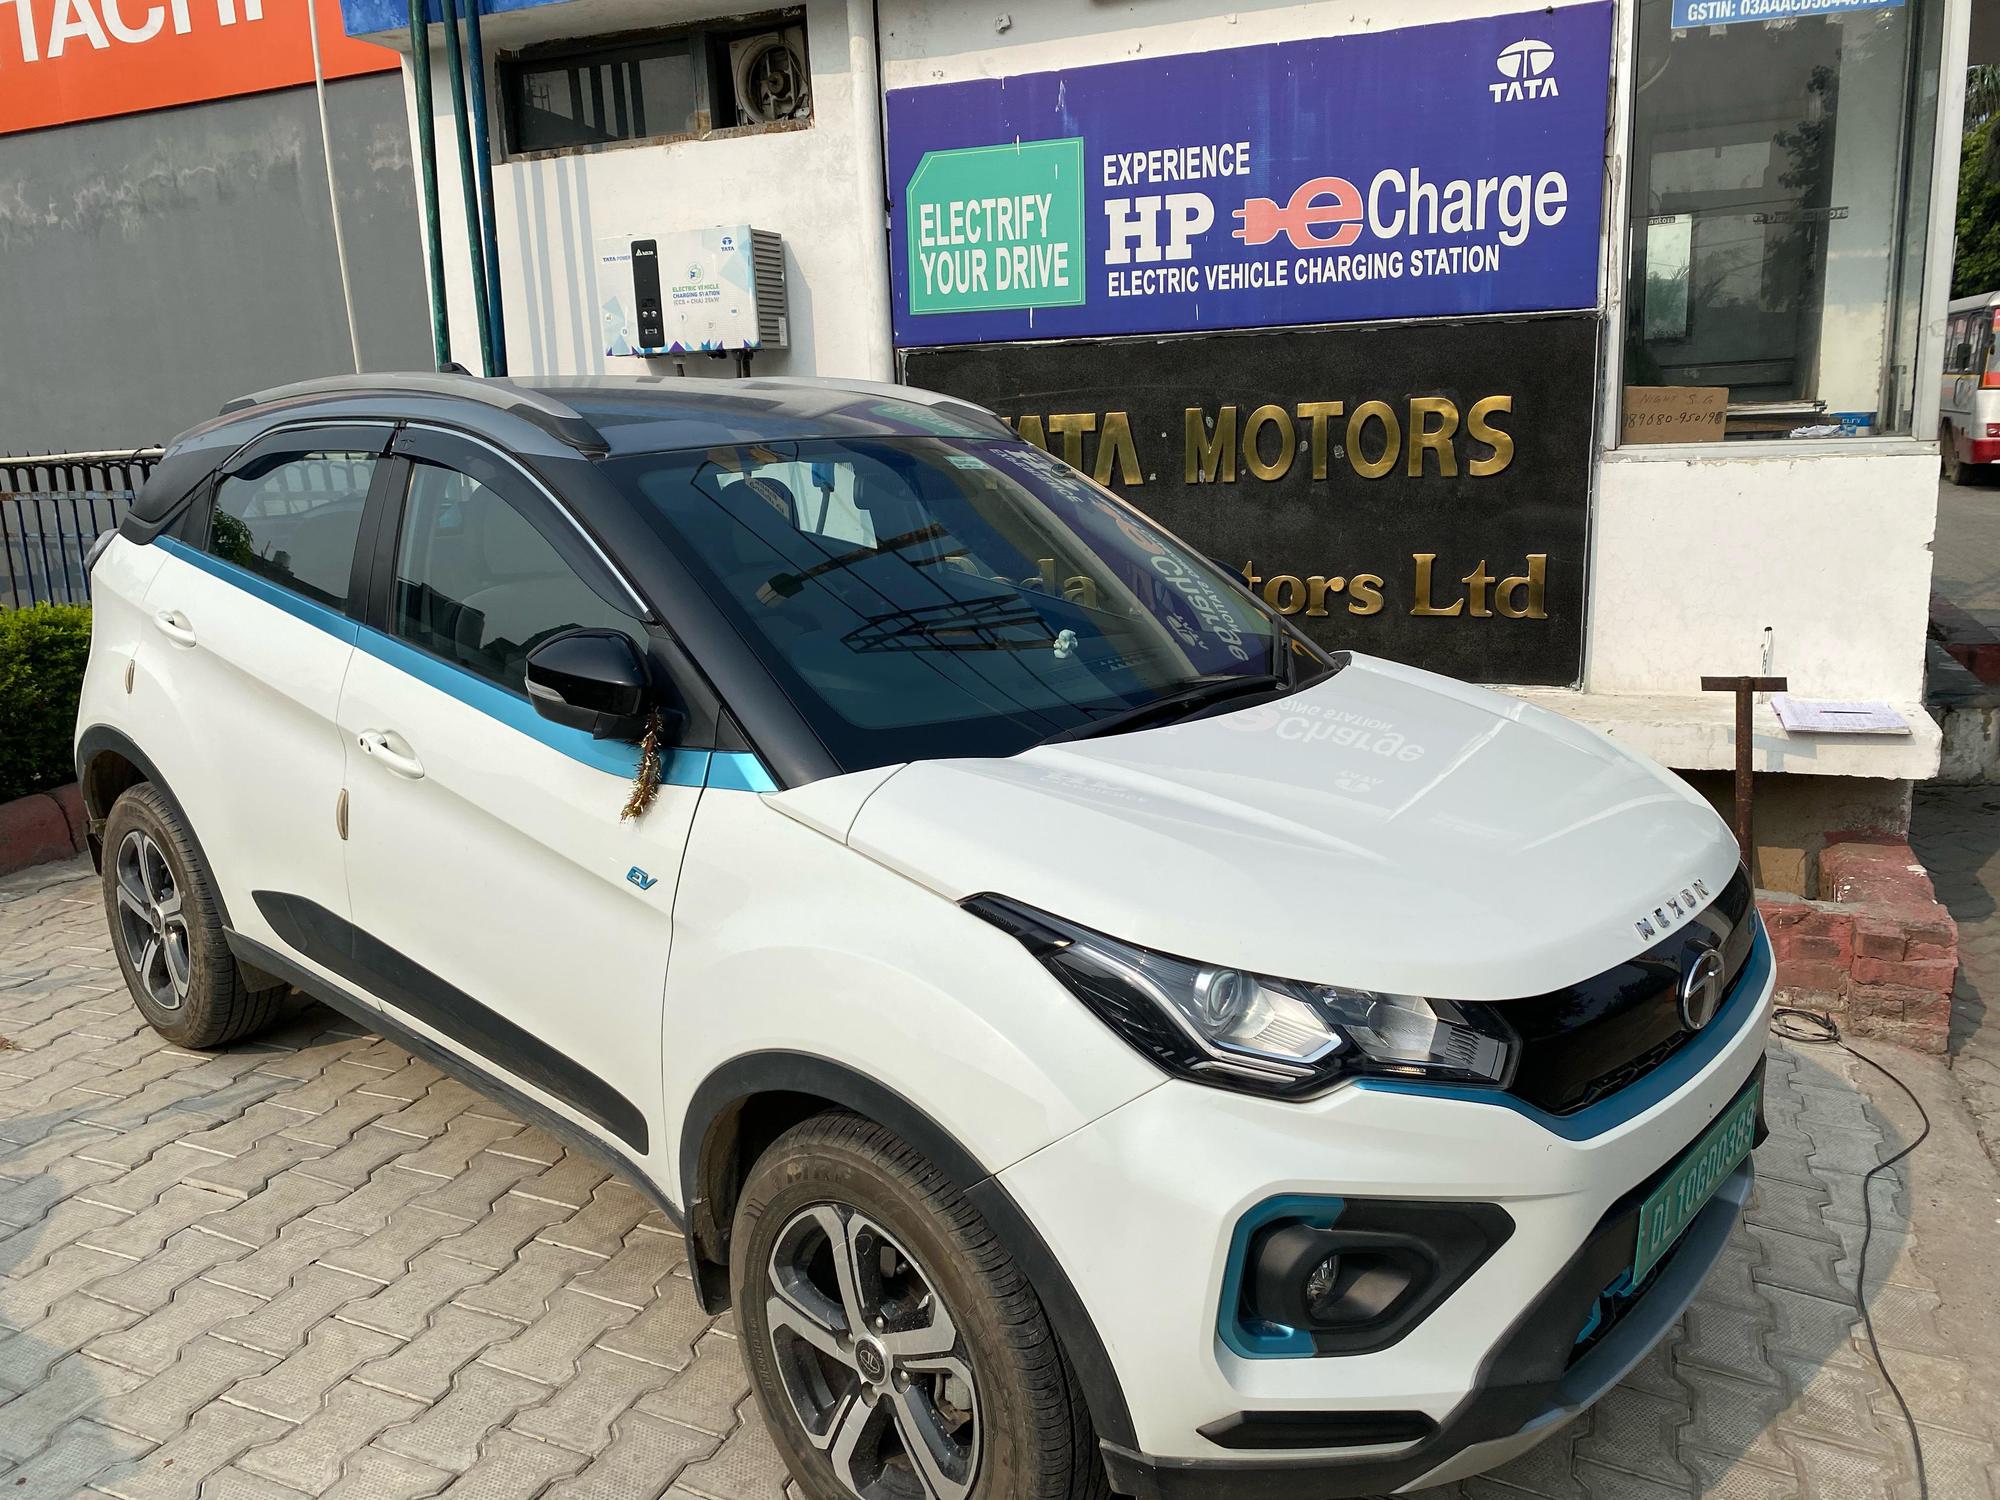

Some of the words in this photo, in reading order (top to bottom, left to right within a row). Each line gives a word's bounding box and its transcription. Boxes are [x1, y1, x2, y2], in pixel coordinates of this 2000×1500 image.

[1688, 2, 1736, 21] GSTIN:
[1489, 77, 1558, 103] TATA
[1103, 141, 1250, 186] EXPERIENCE
[920, 193, 1052, 247] ELECTRIFY
[1104, 192, 1215, 265] HP
[920, 249, 989, 295] YOUR
[996, 242, 1069, 291] DRIVE
[1108, 266, 1199, 297] ELECTRIC
[1205, 260, 1288, 291] VEHICLE
[1294, 251, 1404, 286] CHARGING
[1410, 244, 1499, 276] STATION
[1002, 411, 1144, 486] ATA
[1185, 395, 1514, 484] MOTORS
[1410, 553, 1548, 620] Ltd
[626, 866, 659, 890] EV
[1634, 879, 1710, 941] NEXON
[1651, 1194, 1673, 1250] DL
